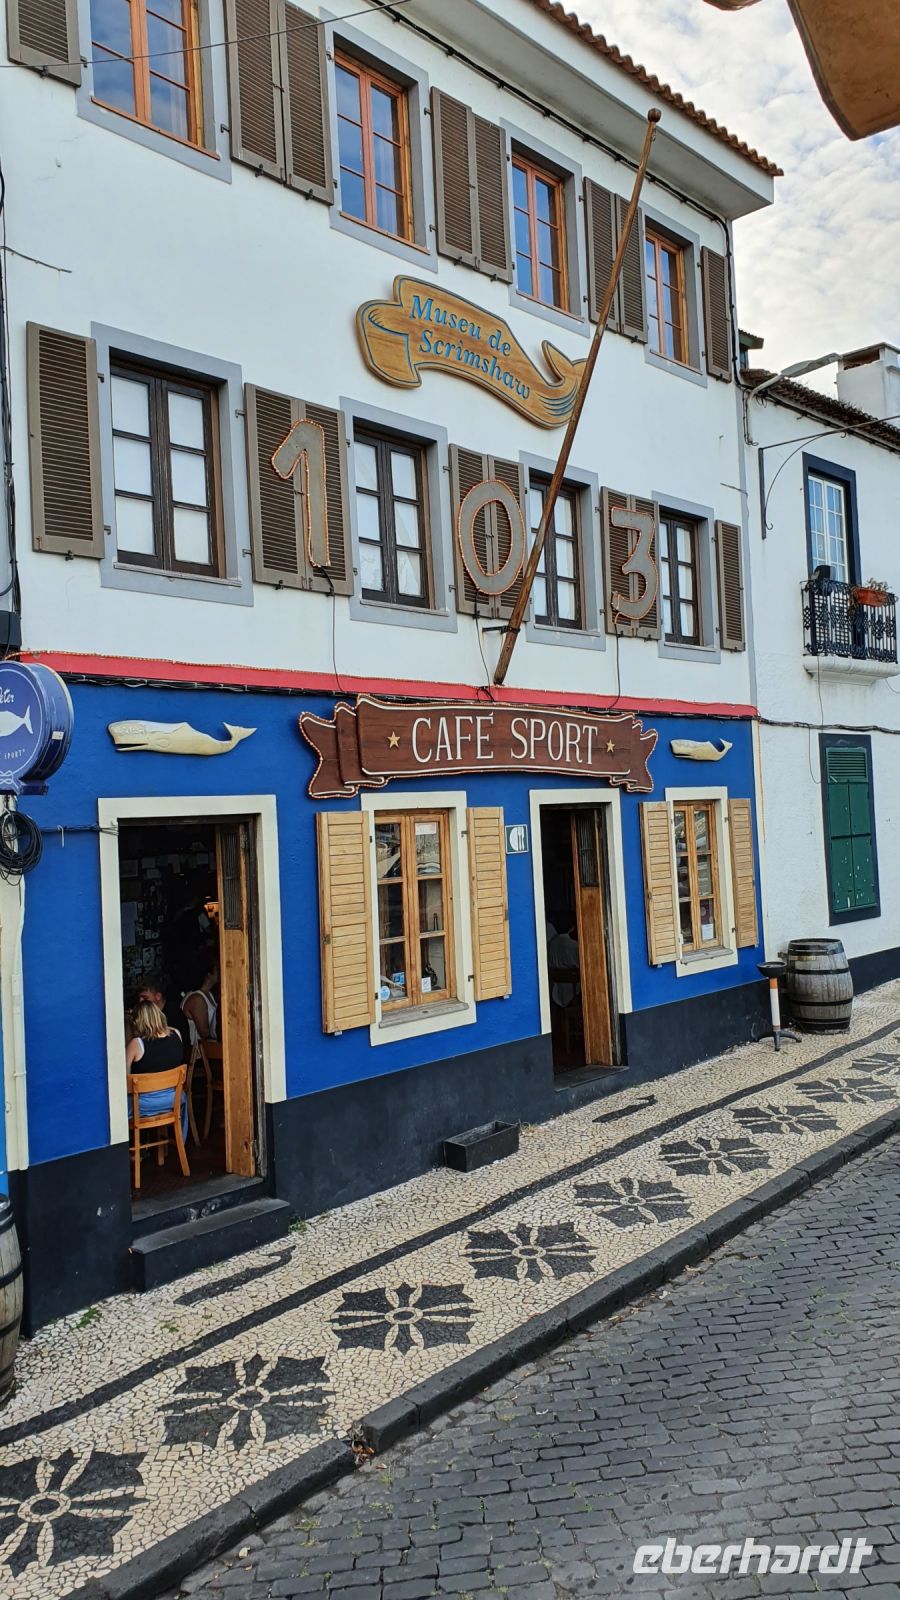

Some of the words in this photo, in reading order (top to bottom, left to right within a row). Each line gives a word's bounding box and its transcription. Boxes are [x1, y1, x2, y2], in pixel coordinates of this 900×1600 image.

[409, 295, 482, 340] Museu
[488, 329, 511, 357] de
[418, 330, 531, 400] Scrimshaw
[411, 712, 494, 763] CAFÉ
[510, 717, 599, 765] SPORT
